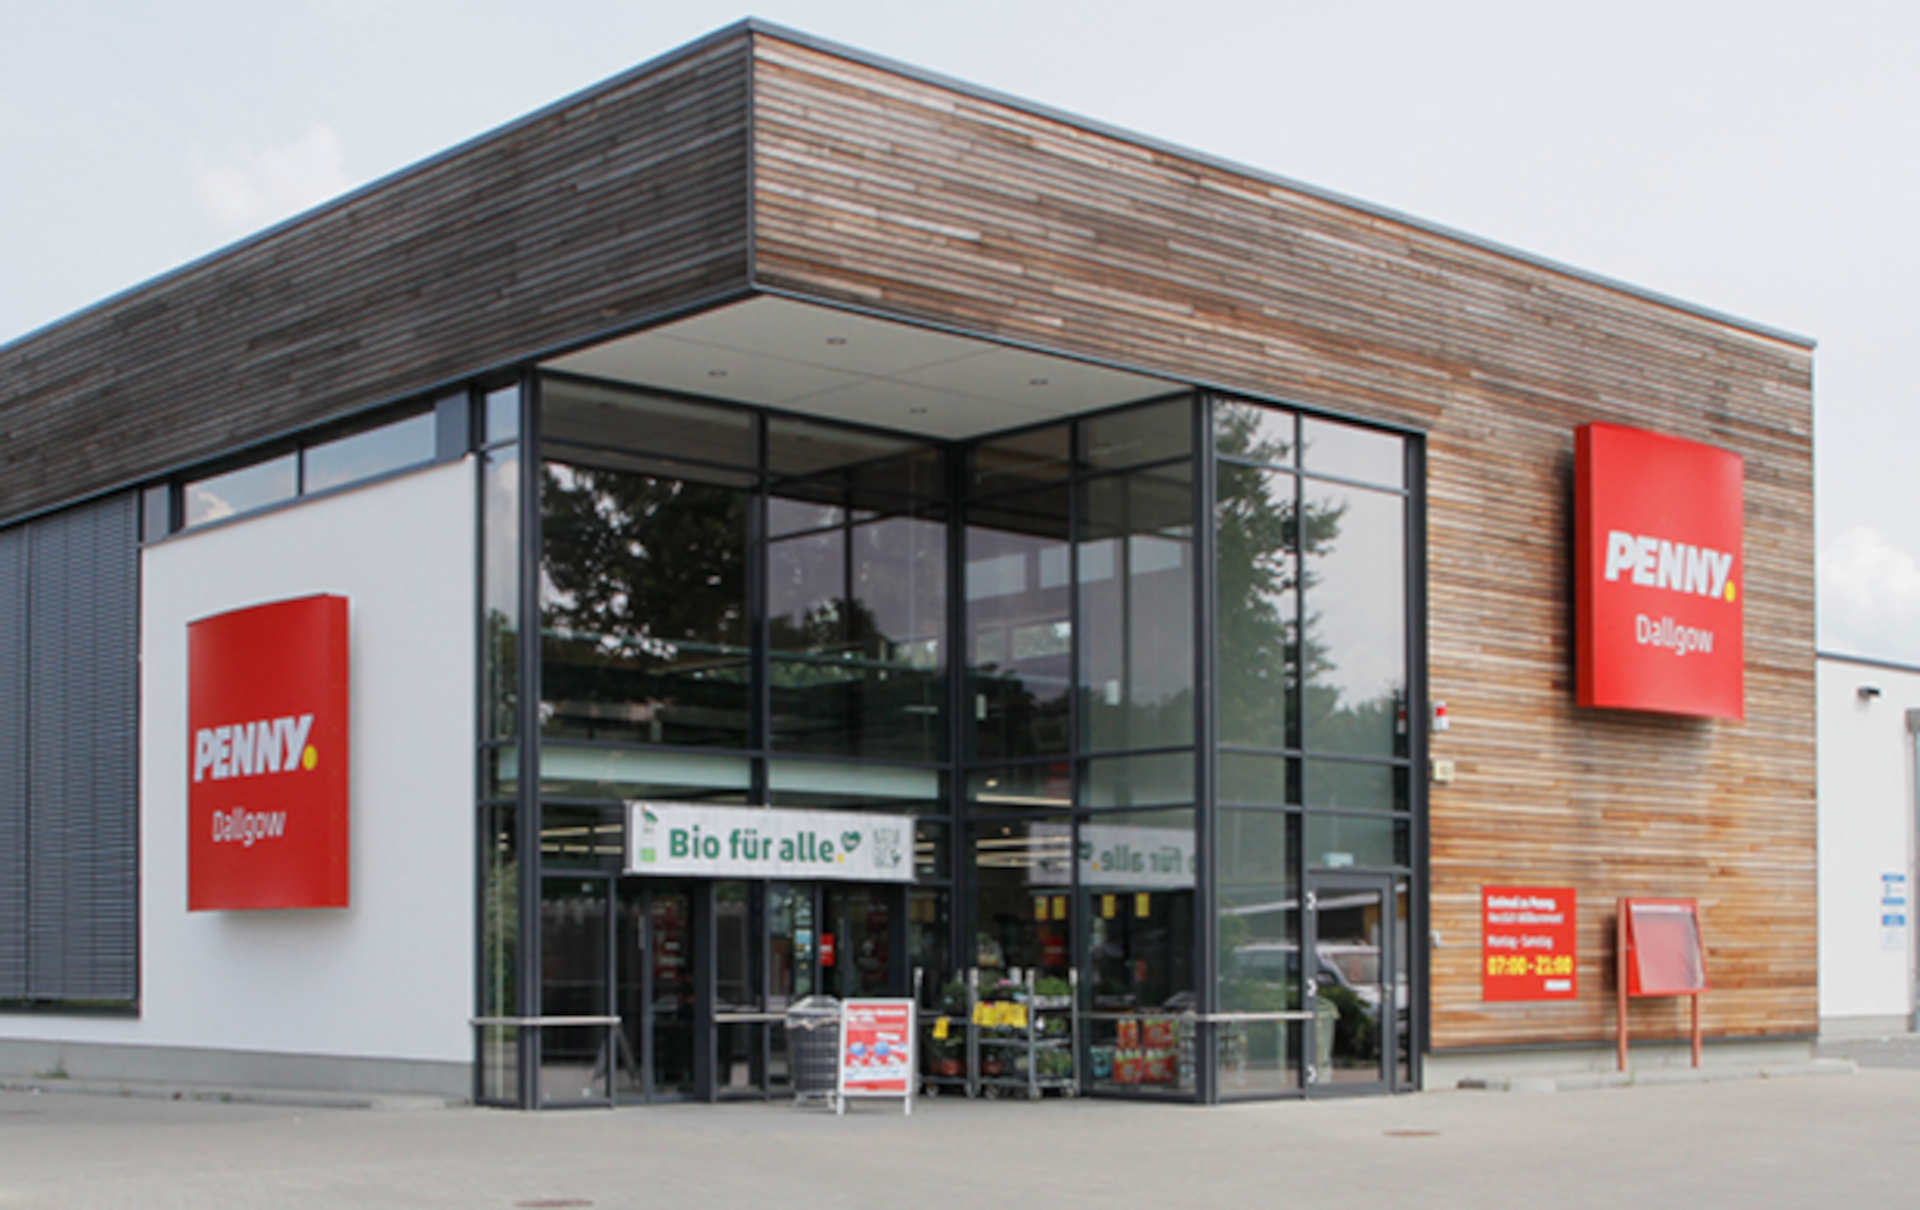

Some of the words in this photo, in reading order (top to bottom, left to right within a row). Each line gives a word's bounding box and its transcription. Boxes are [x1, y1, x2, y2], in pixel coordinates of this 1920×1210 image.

[1636, 614, 1714, 656] Dallgow
[213, 806, 286, 846] Dallgow
[669, 825, 720, 858] Bio
[729, 828, 772, 860] für
